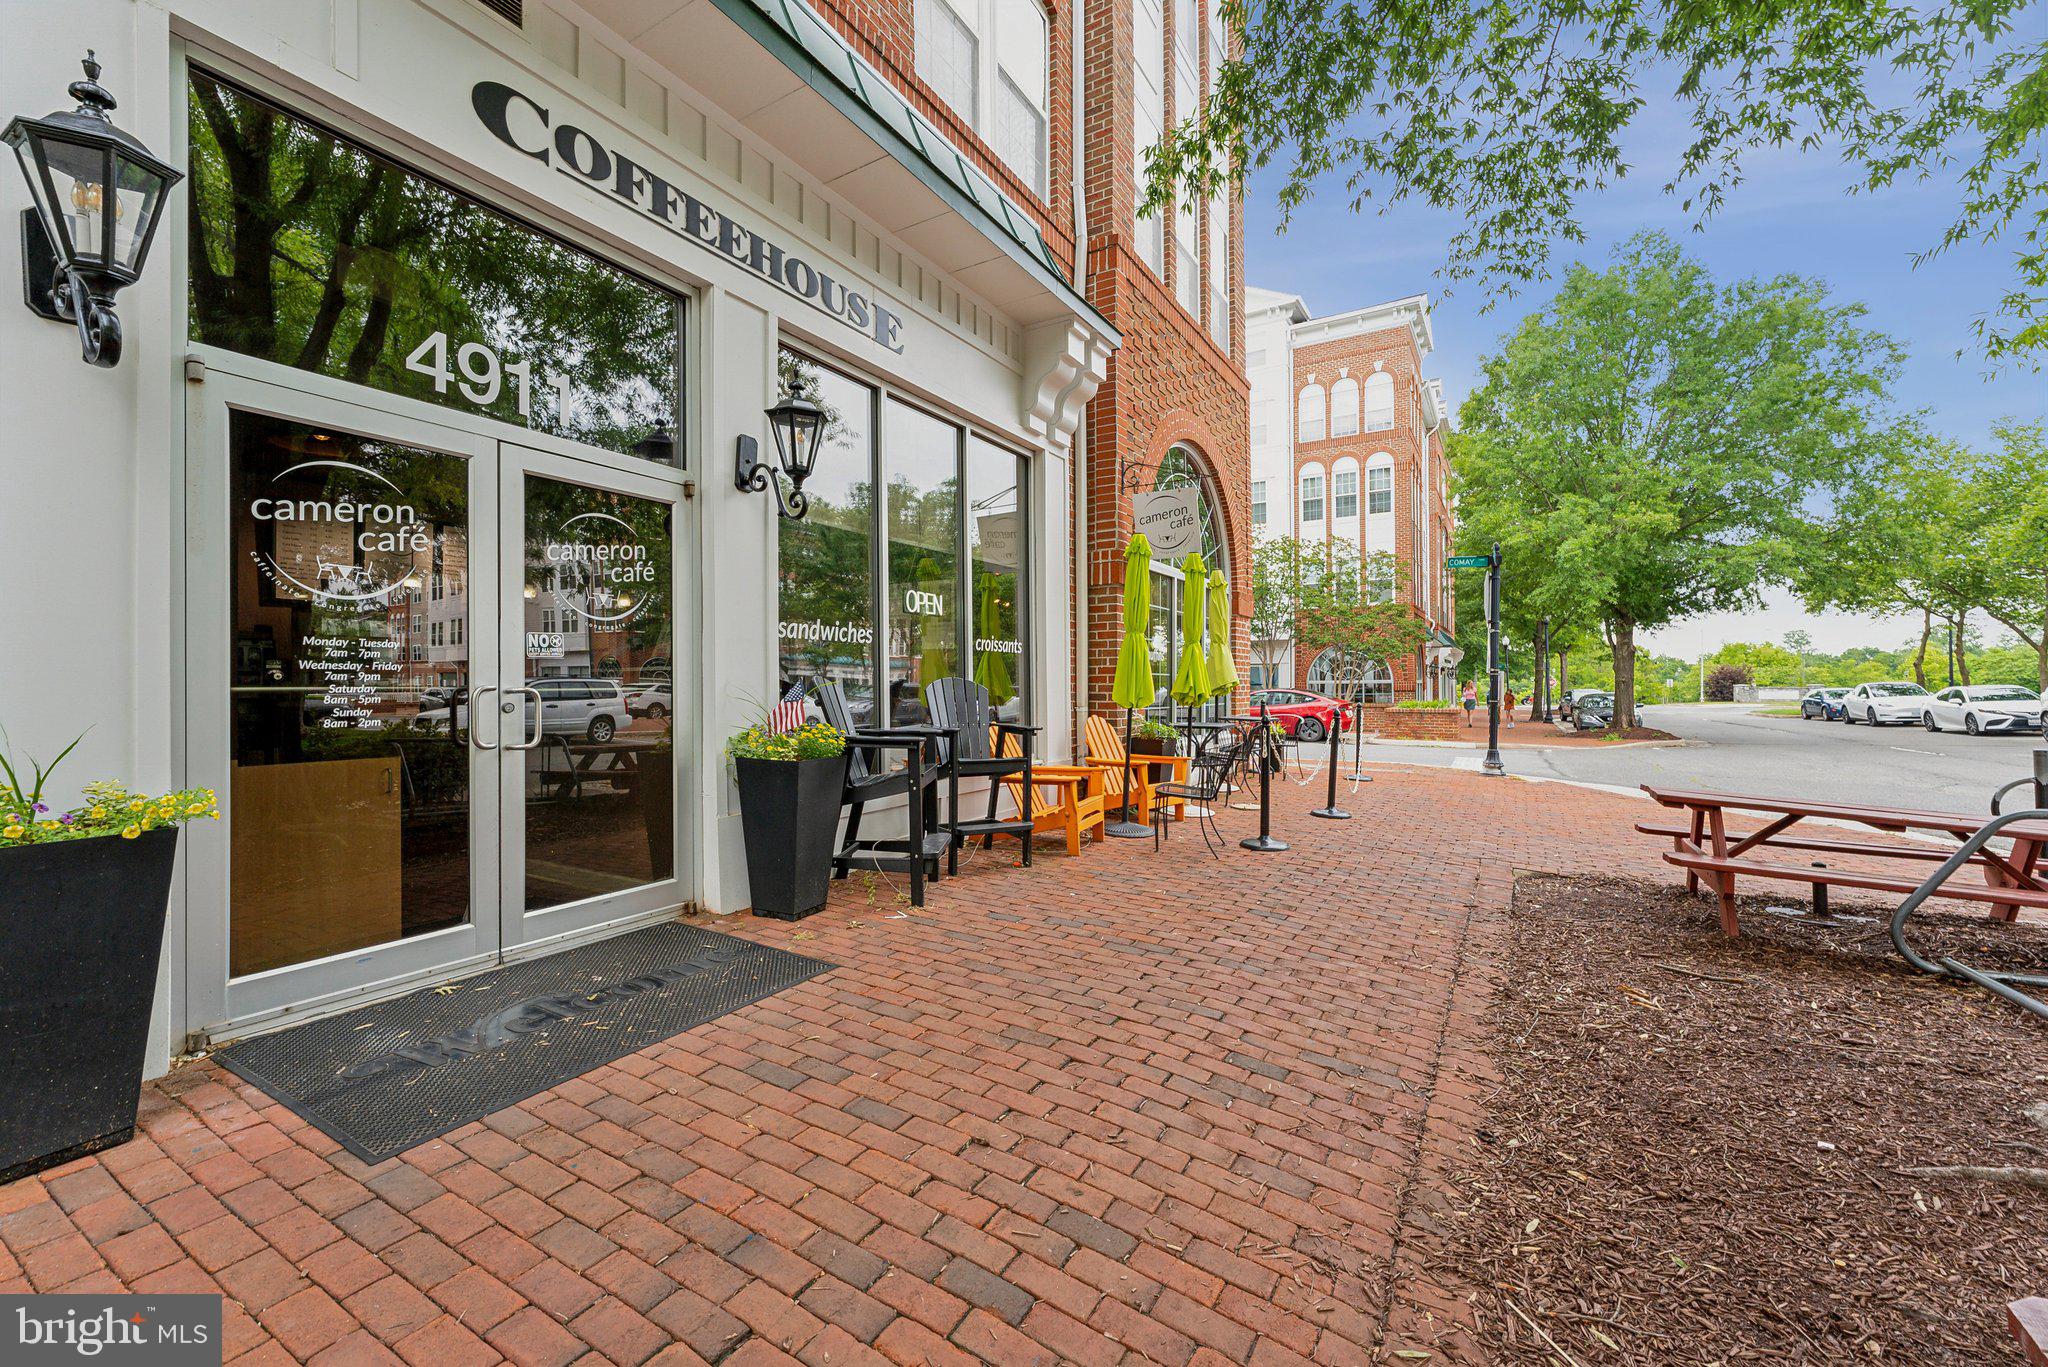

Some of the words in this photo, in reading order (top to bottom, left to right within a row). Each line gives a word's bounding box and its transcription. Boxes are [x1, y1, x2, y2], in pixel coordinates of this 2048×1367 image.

[472, 81, 904, 355] COFFEEHOUSE
[405, 331, 569, 427] 4911
[250, 498, 414, 524] cameron
[1140, 506, 1188, 526] cameron
[1170, 514, 1194, 529] café
[358, 525, 430, 552] café
[547, 543, 646, 561] cameron
[1449, 558, 1475, 566] COMAY
[250, 551, 300, 598] caffeinate
[611, 561, 655, 582] café
[906, 589, 943, 616] OPEN
[778, 619, 873, 644] sandwiches
[302, 636, 349, 648] Monday
[359, 638, 400, 649] Tuesday
[528, 633, 549, 648] NO
[975, 636, 1022, 654] croissants
[325, 648, 347, 657] 7am
[358, 649, 380, 659] 7pm
[299, 660, 363, 671] Wednesday
[372, 661, 403, 672] Friday
[324, 672, 347, 680] 7am
[358, 672, 380, 682] 9pm
[328, 684, 377, 695] Saturday
[323, 695, 347, 704] 8am
[358, 695, 381, 705] 5pm
[332, 708, 373, 718] Sunday
[323, 719, 347, 728] 8am
[358, 718, 381, 728] 2pm
